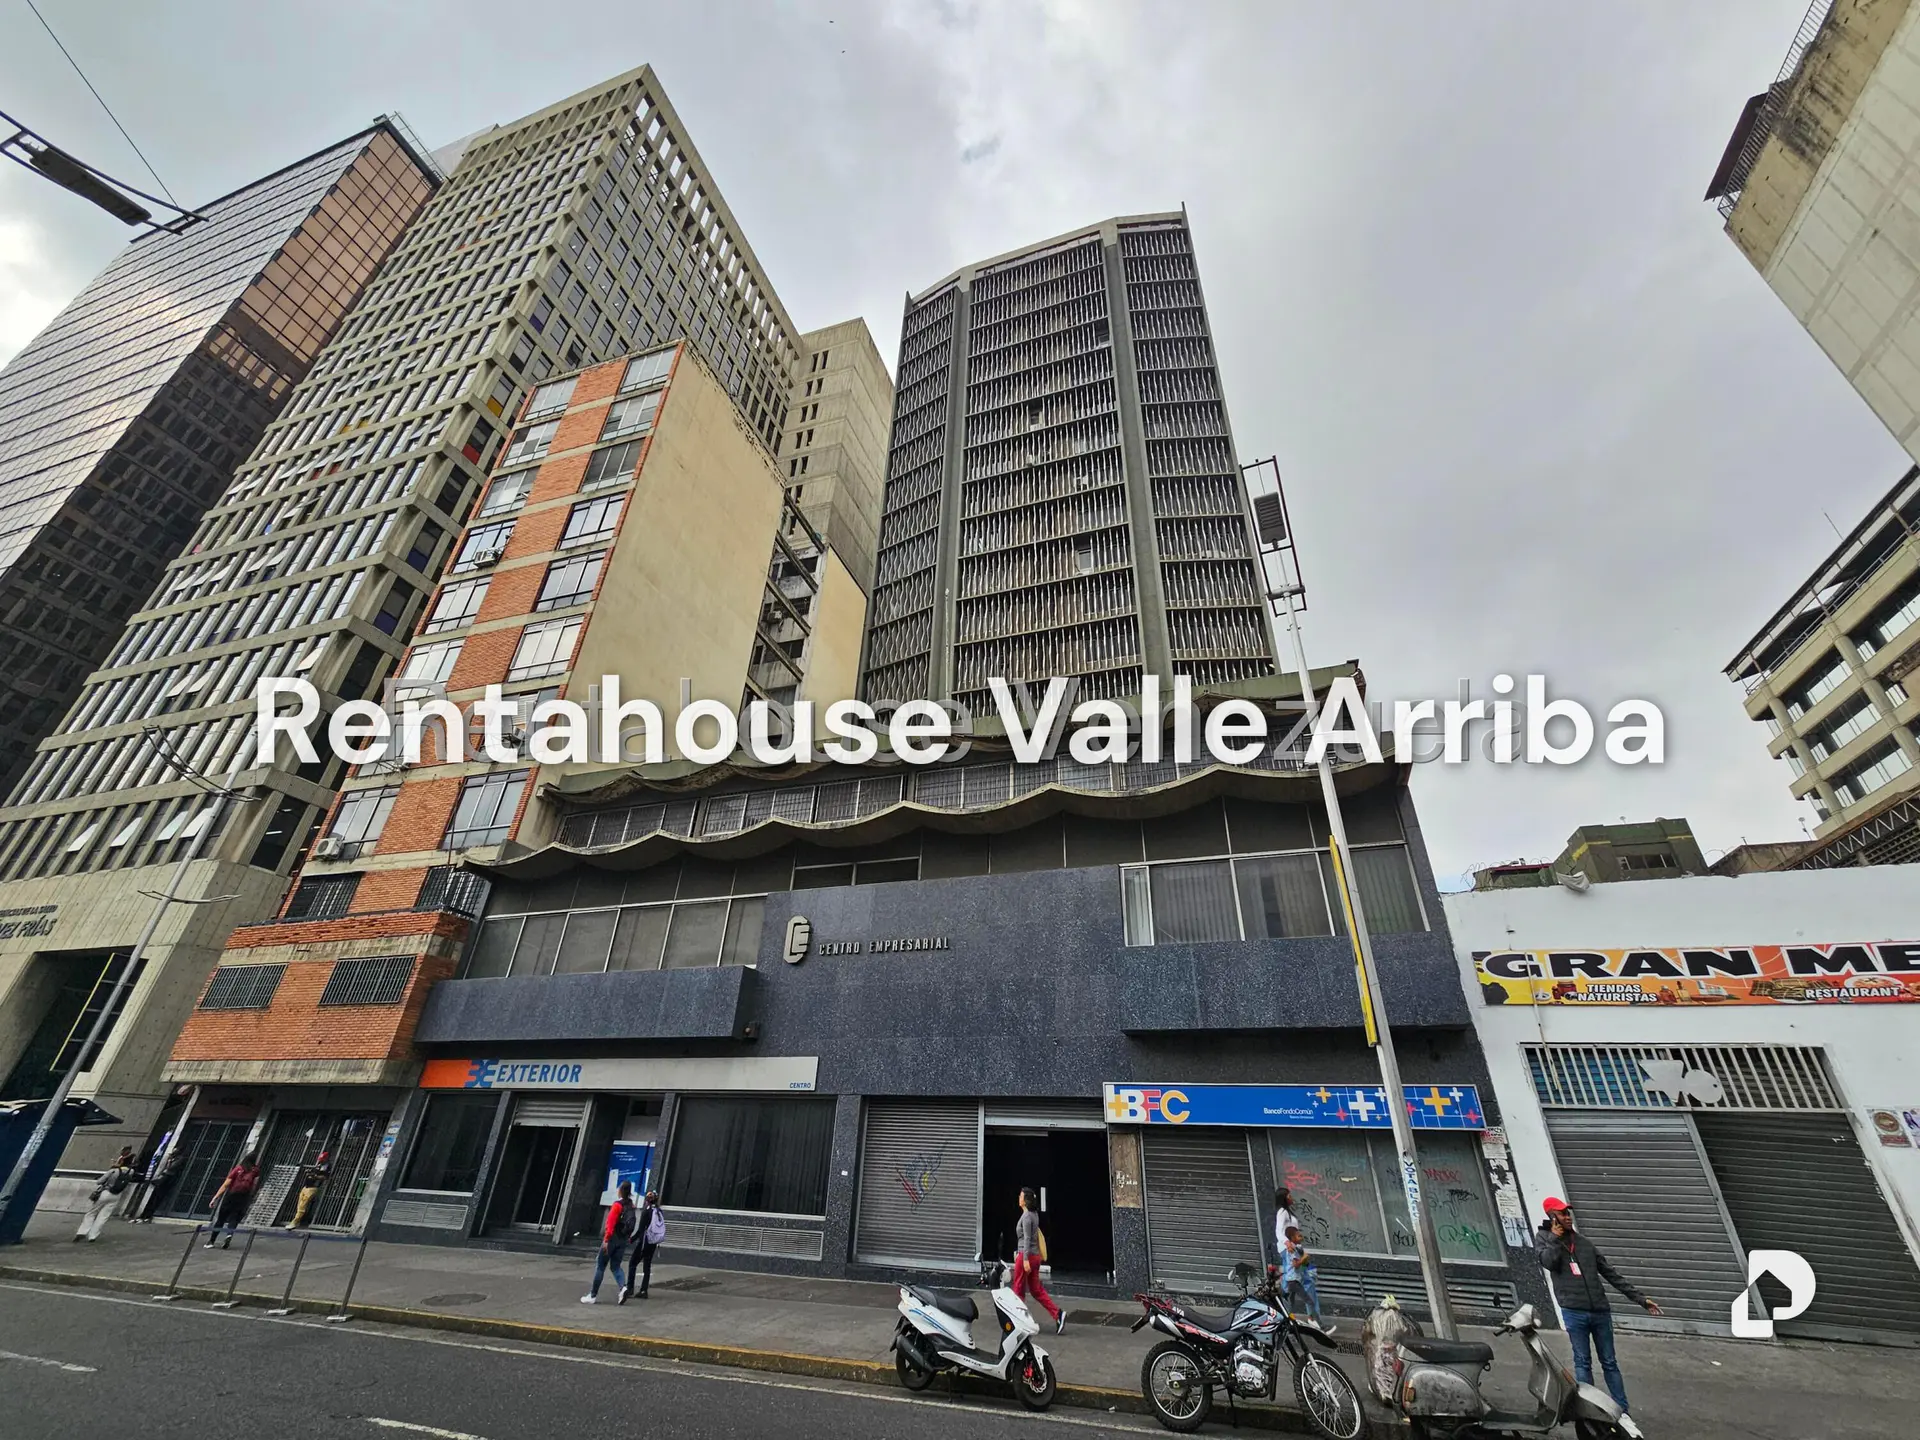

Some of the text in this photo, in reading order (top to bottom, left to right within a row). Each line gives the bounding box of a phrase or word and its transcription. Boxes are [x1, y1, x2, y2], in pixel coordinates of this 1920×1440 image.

[819, 936, 949, 955] CENTRO EMPRESARIAL
[1484, 949, 1761, 979] GRAN
[1586, 984, 1642, 993] TIENDAS
[1805, 986, 1900, 999] RESTAURANT
[1577, 992, 1658, 1002] NATURISTAS
[496, 1064, 583, 1083] EXTERIOR
